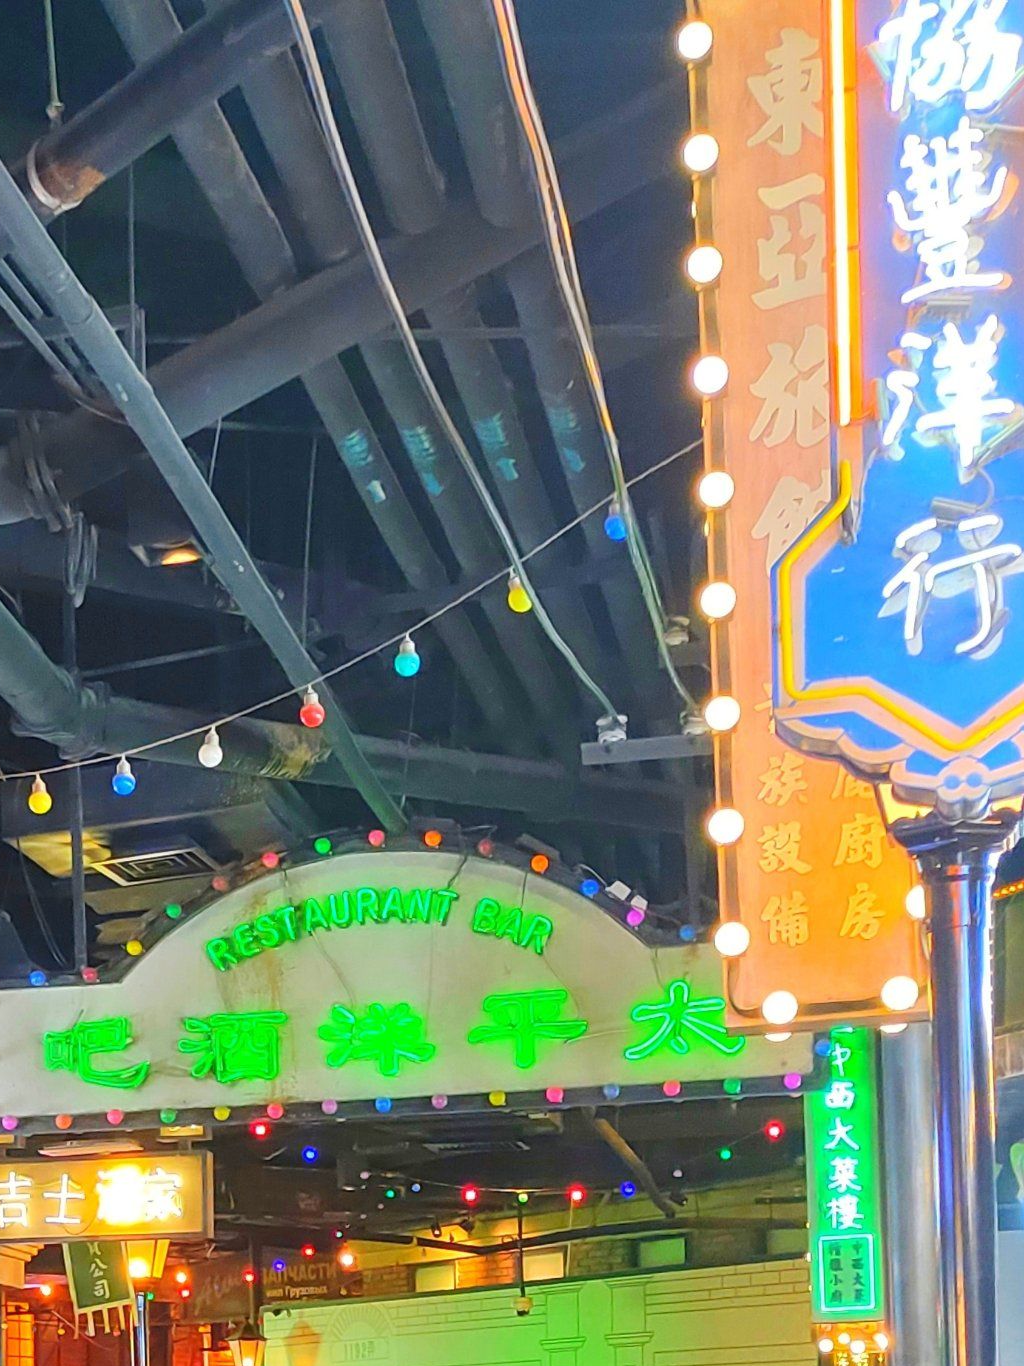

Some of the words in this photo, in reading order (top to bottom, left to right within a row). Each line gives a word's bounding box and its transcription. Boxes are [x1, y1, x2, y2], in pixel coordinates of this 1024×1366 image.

[754, 683, 813, 948] 族設備
[205, 887, 459, 972] RESTAURANT
[472, 897, 554, 955] BAR
[824, 1026, 865, 1230] 中西大菜樓
